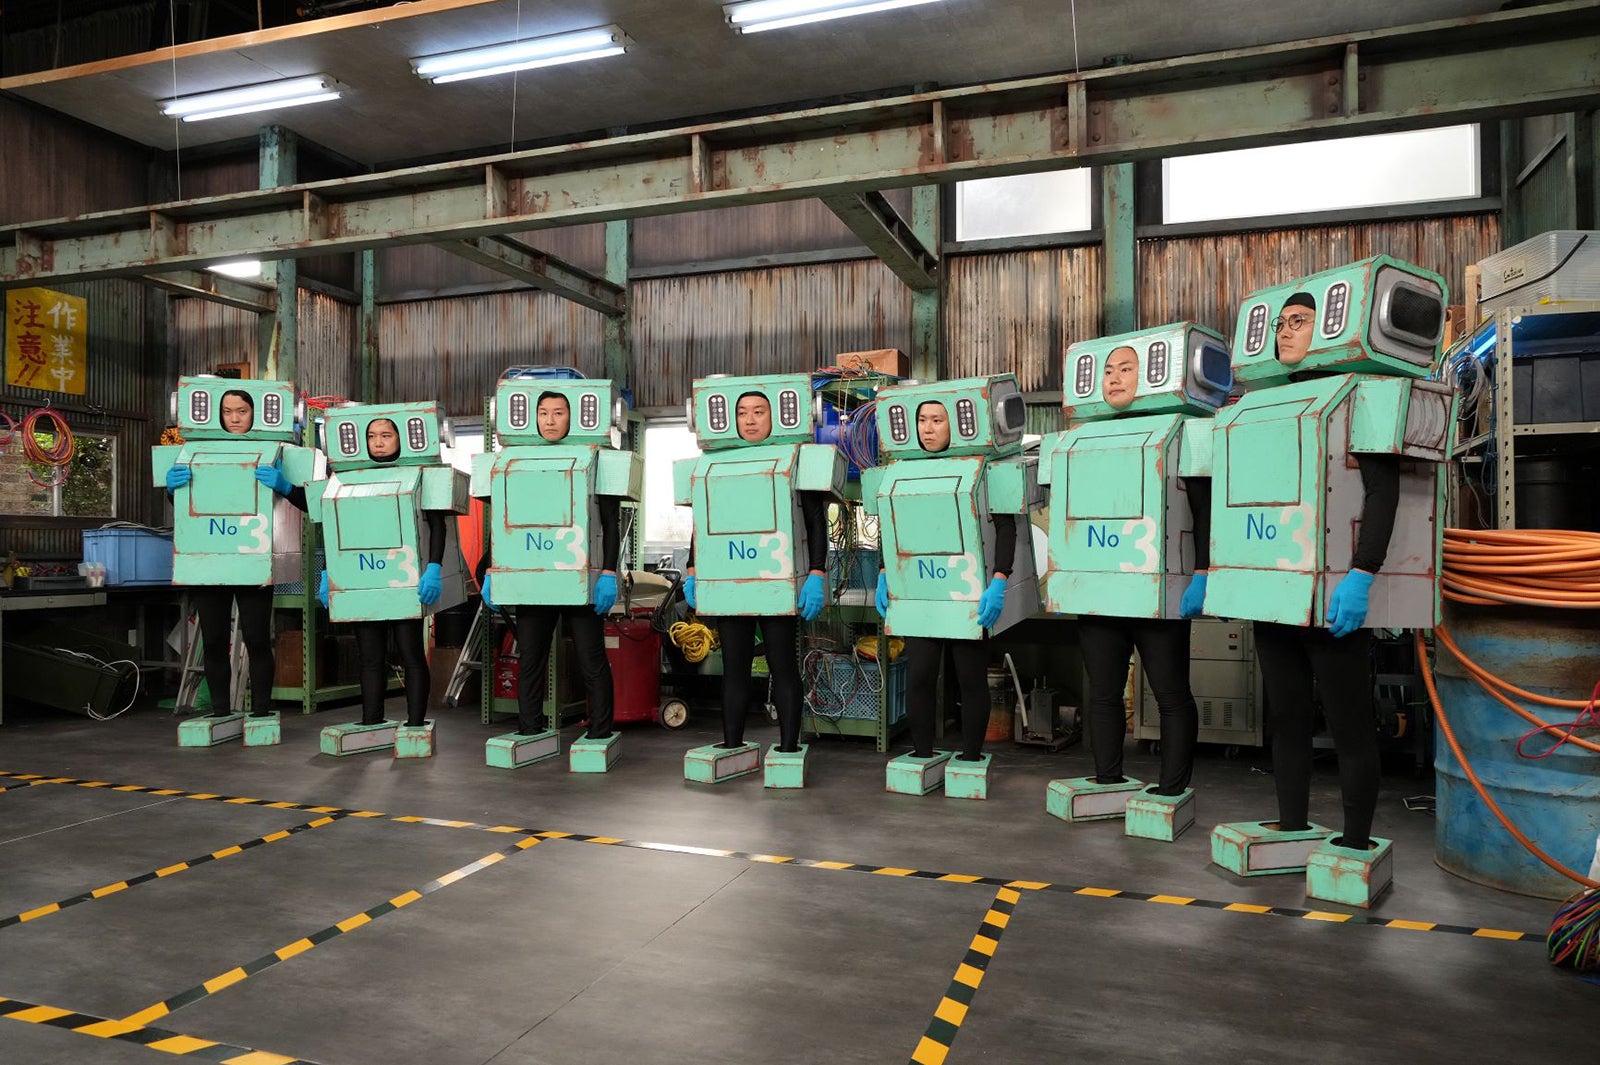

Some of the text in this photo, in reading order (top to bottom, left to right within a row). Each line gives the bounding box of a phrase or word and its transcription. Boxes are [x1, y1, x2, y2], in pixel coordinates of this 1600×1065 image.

[47, 301, 77, 392] 作業中
[209, 513, 270, 553] No 3
[526, 525, 586, 569] No 3
[729, 531, 792, 579] No 3
[1088, 517, 1158, 573] No 3
[1247, 502, 1315, 570] No 3
[359, 545, 419, 587] No 3
[918, 552, 982, 601] No 3
